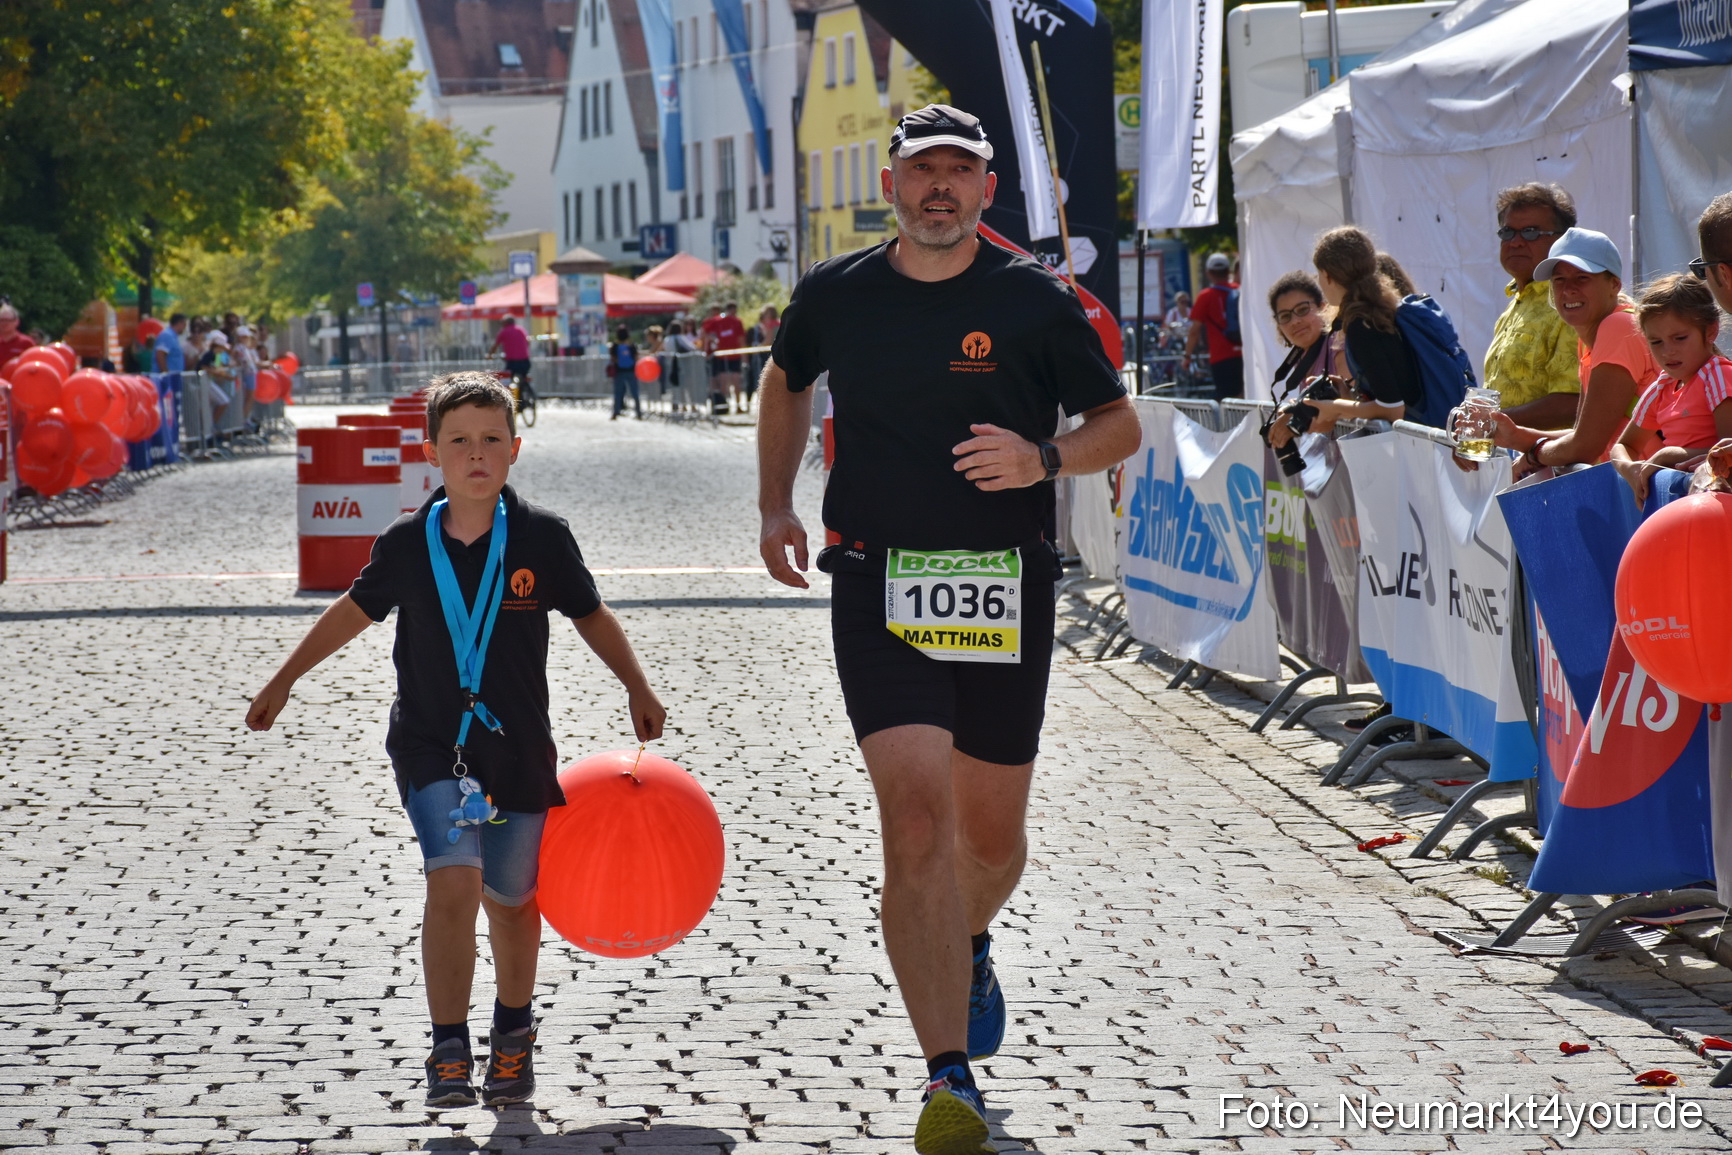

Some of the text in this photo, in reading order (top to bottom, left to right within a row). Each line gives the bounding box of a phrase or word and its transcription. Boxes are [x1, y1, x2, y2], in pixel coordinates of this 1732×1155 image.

[1192, 127, 1206, 207] PARTL
[312, 497, 363, 519] AVIA
[898, 552, 1011, 574] BOCK
[904, 582, 1006, 620] 1036
[903, 629, 1004, 648] MATTHIAS
